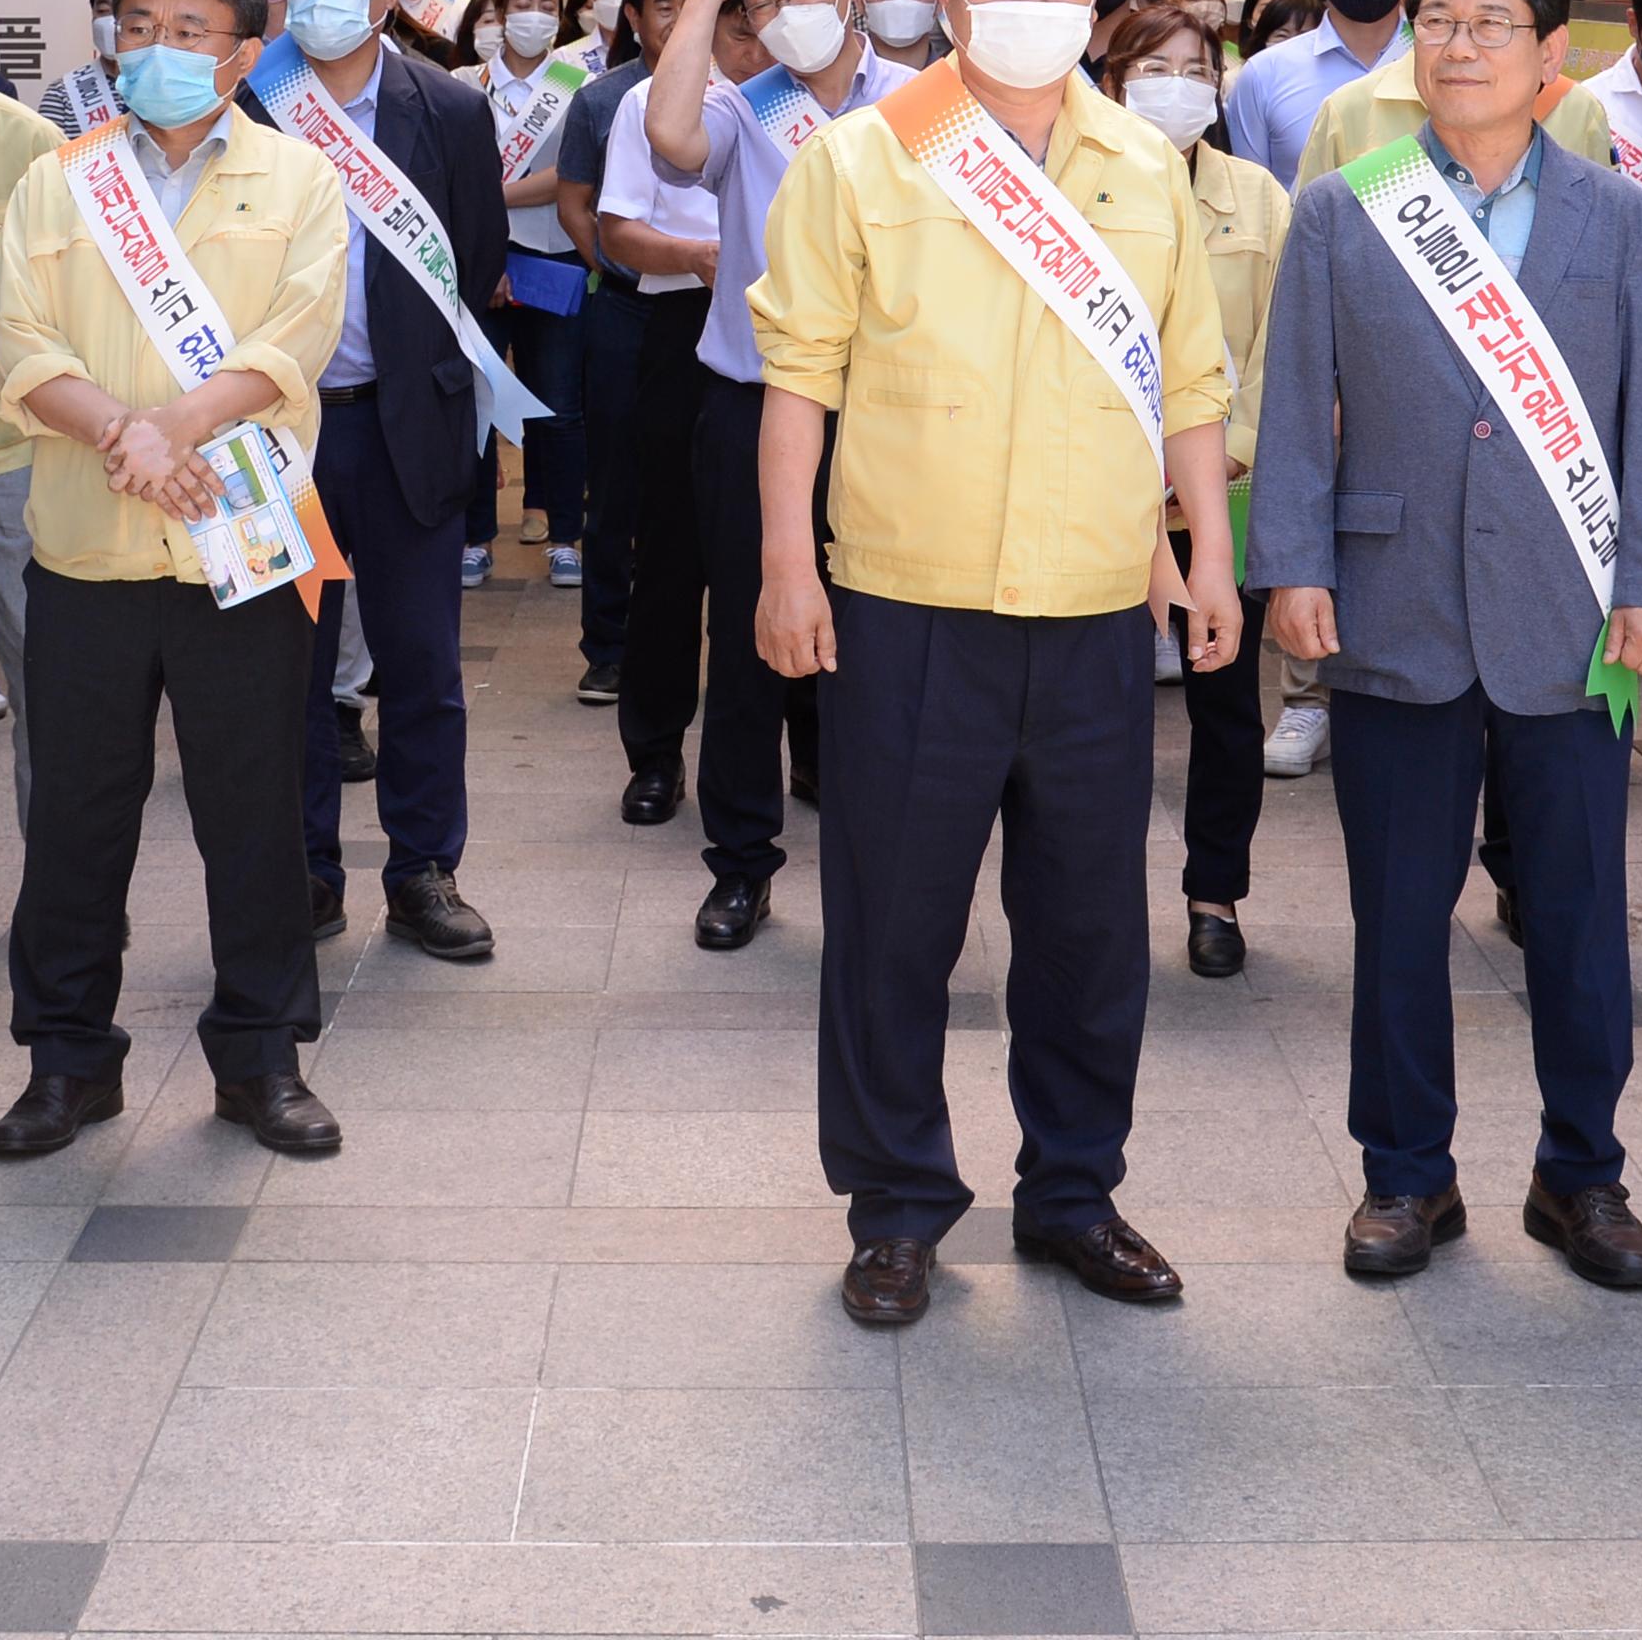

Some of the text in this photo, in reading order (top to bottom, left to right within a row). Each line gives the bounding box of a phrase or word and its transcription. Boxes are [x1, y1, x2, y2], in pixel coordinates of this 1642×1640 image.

[83, 150, 169, 288] 긴급재난지원금
[149, 277, 200, 333] 쓰고
[287, 91, 399, 214] 긴급재난지원금
[382, 196, 429, 249] 받고
[951, 136, 1136, 347] 긴급재난지원금 쓰고
[1396, 191, 1487, 296] 오늘은
[1455, 281, 1585, 464] 재난지원금
